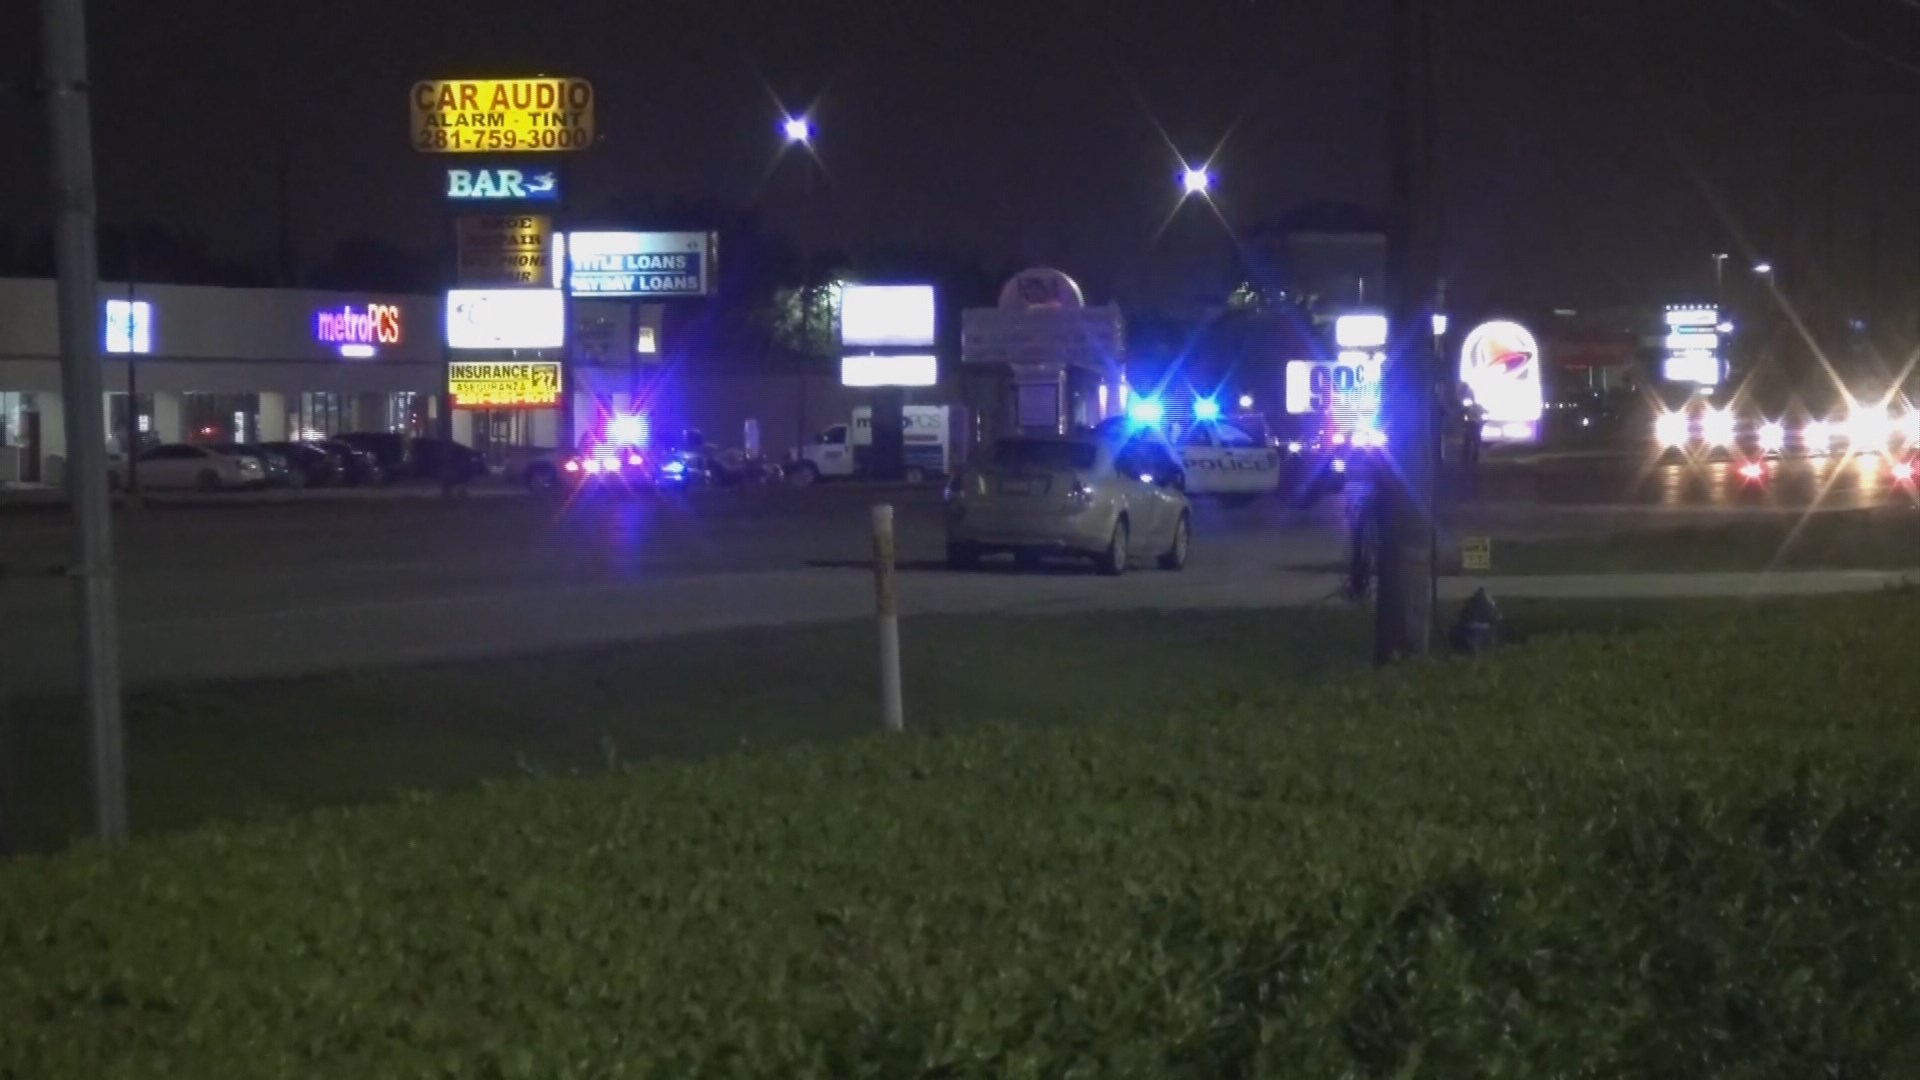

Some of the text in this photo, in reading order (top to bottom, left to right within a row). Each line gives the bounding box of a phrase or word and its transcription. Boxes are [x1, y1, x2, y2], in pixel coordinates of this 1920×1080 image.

[415, 82, 590, 111] CAR AUDIO
[425, 112, 505, 127] ALARM
[528, 111, 582, 127] TINT
[420, 129, 587, 149] 281-759-3000
[448, 169, 526, 198] BAR
[627, 255, 687, 270] LOANS
[639, 275, 698, 291] LOANS
[318, 302, 399, 343] metroPCS
[451, 364, 528, 379] INSURANCE
